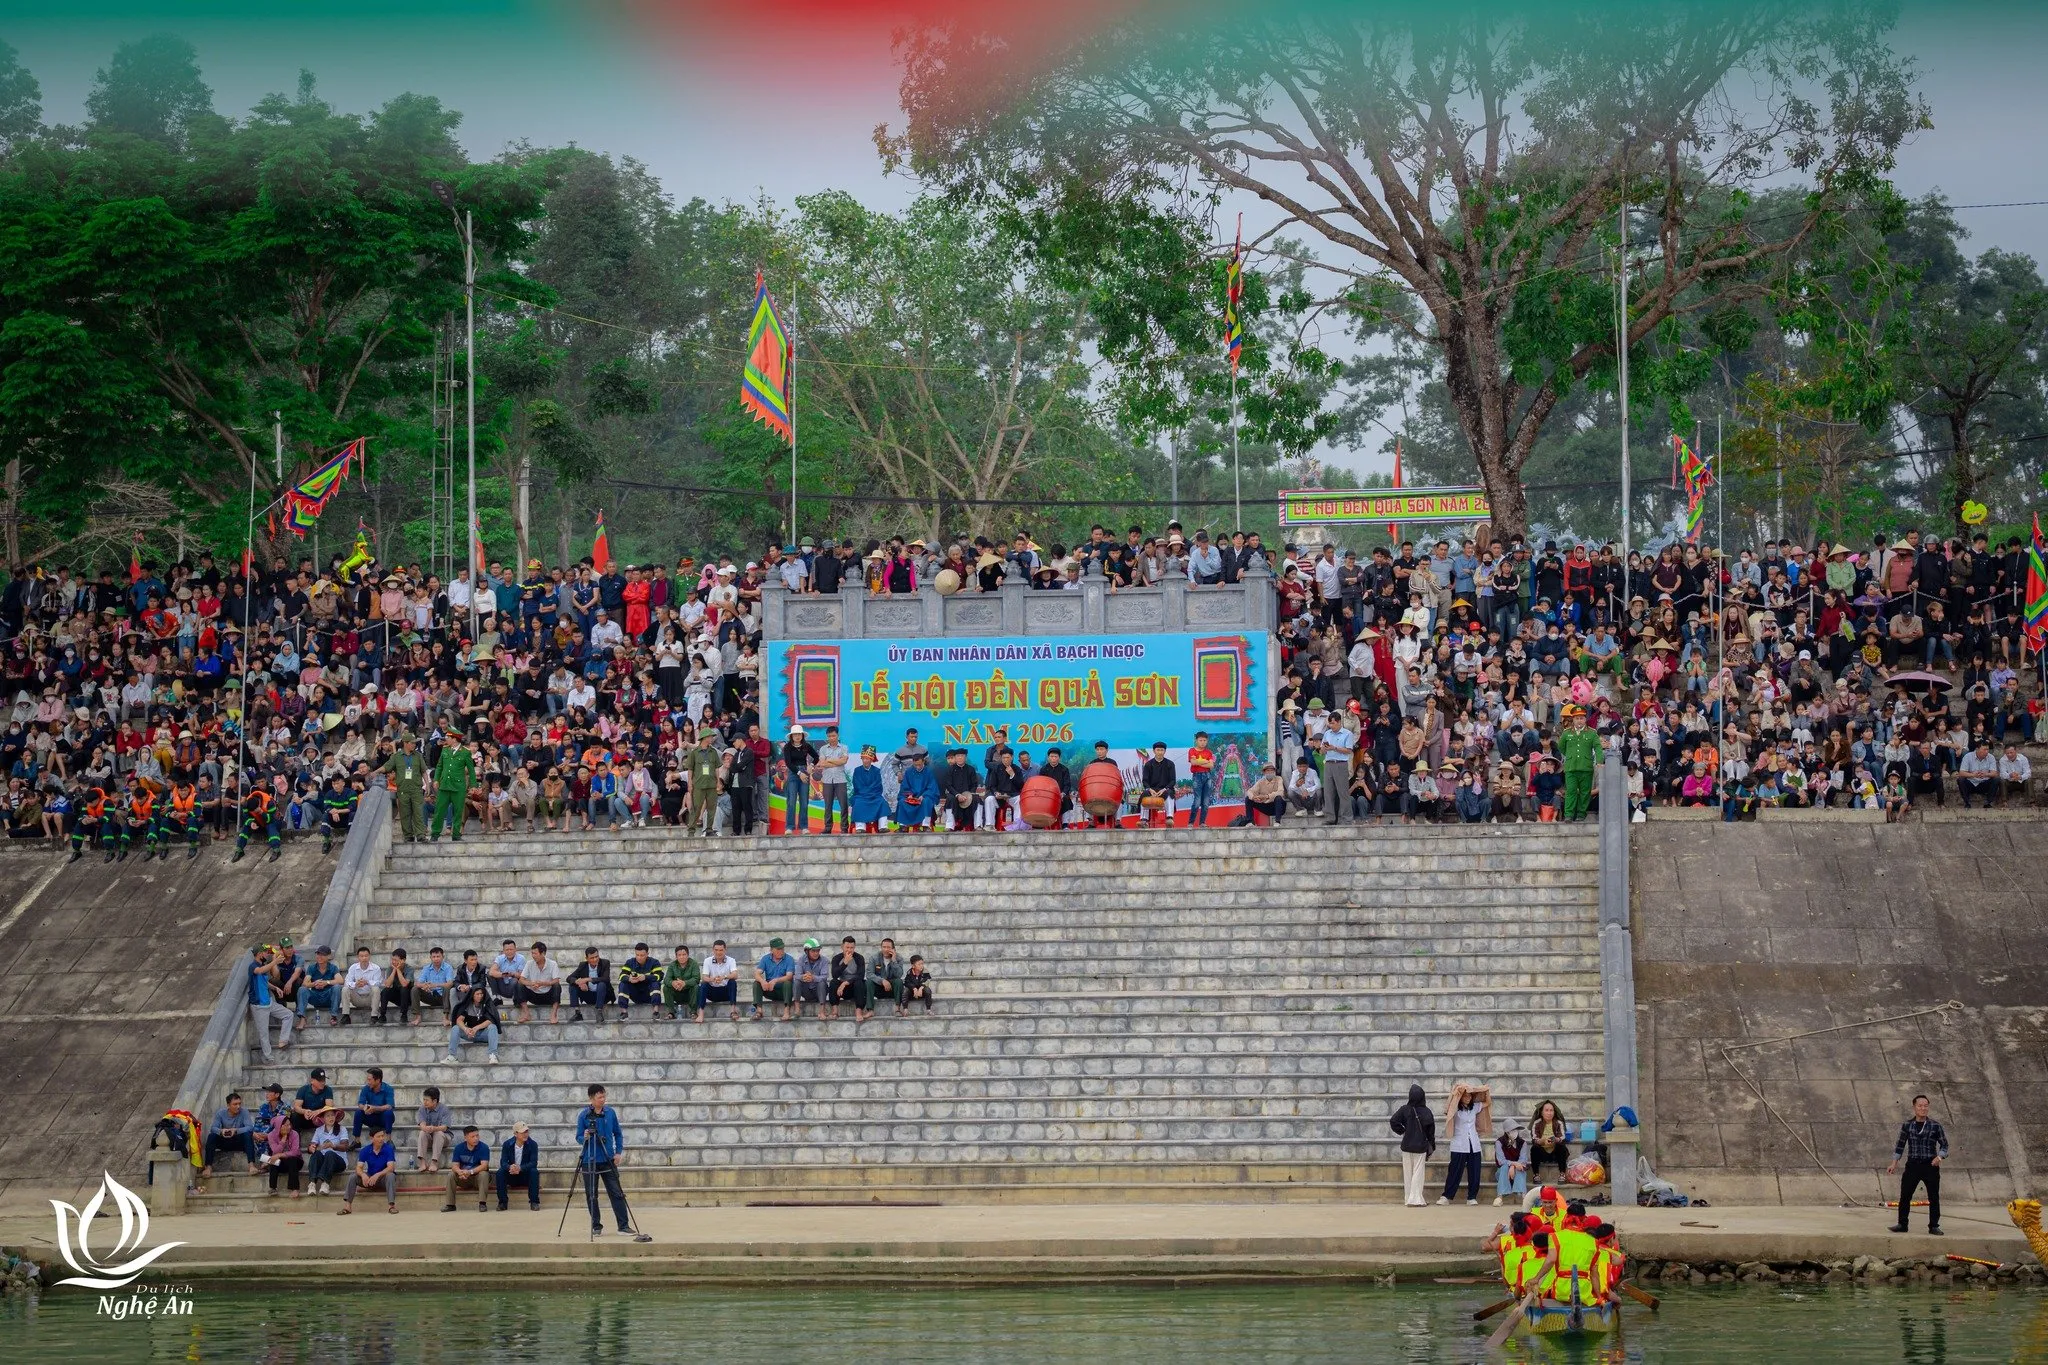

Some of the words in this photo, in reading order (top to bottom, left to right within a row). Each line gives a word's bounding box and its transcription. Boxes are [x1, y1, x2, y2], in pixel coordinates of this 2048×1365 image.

[1440, 494, 1469, 512] NĂM
[1474, 497, 1490, 511] 20
[888, 645, 908, 662] ỦY
[912, 647, 944, 662] BAN
[948, 645, 991, 662] NHÂN
[995, 644, 1027, 660] DÂN
[1032, 643, 1052, 660] XÃ
[1056, 645, 1098, 662] BẠCH
[1102, 644, 1145, 661] NGỌC
[851, 668, 891, 712] LỄ
[899, 673, 958, 718] HỘI
[965, 667, 1031, 711] ĐỀN
[1039, 668, 1106, 716] QUẢ
[1114, 671, 1181, 709] SƠN
[943, 718, 1011, 745] NĂM
[1017, 722, 1075, 744] 2026
